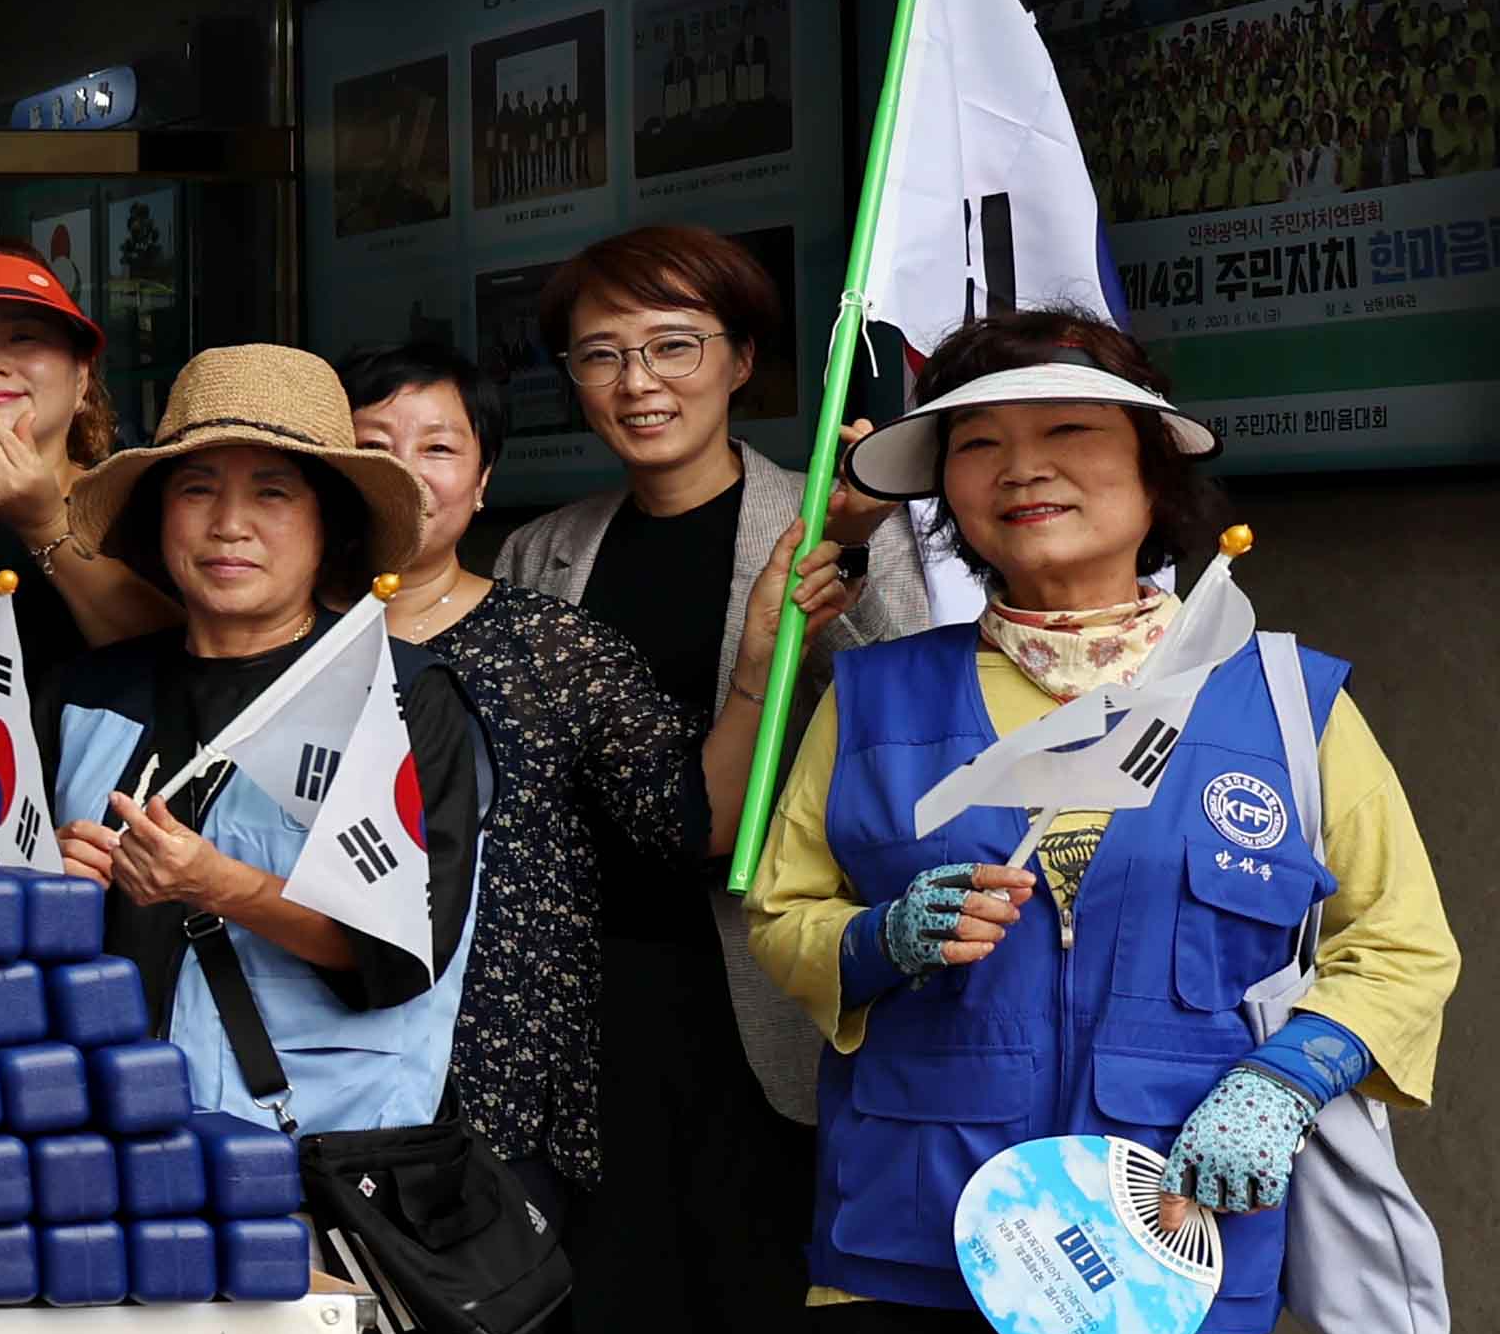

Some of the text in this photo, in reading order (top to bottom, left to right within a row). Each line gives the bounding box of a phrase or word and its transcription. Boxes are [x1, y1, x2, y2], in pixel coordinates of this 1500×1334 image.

[1187, 201, 1383, 246] 인천광역시 주민자치연합회
[1215, 236, 1358, 302] 주민자치
[1235, 412, 1298, 438] 주민자치
[1304, 406, 1388, 434] 한마음대회
[1221, 796, 1271, 828] KFF
[1060, 1229, 1106, 1289] 111
